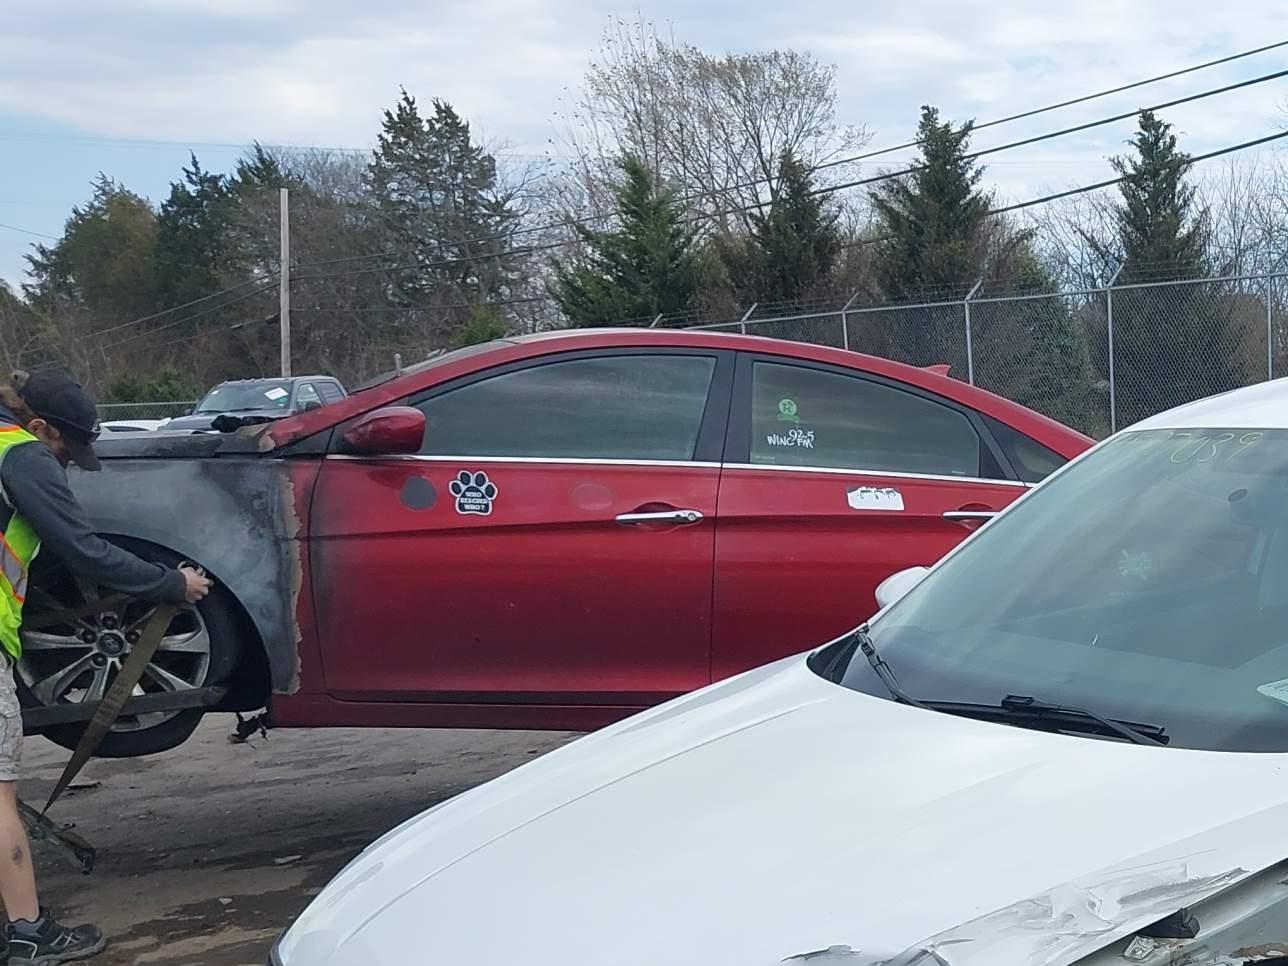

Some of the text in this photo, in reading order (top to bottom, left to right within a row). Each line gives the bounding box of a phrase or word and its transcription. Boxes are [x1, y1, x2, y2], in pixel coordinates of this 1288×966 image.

[767, 434, 814, 449] WINC FM
[789, 429, 814, 442] 92.5
